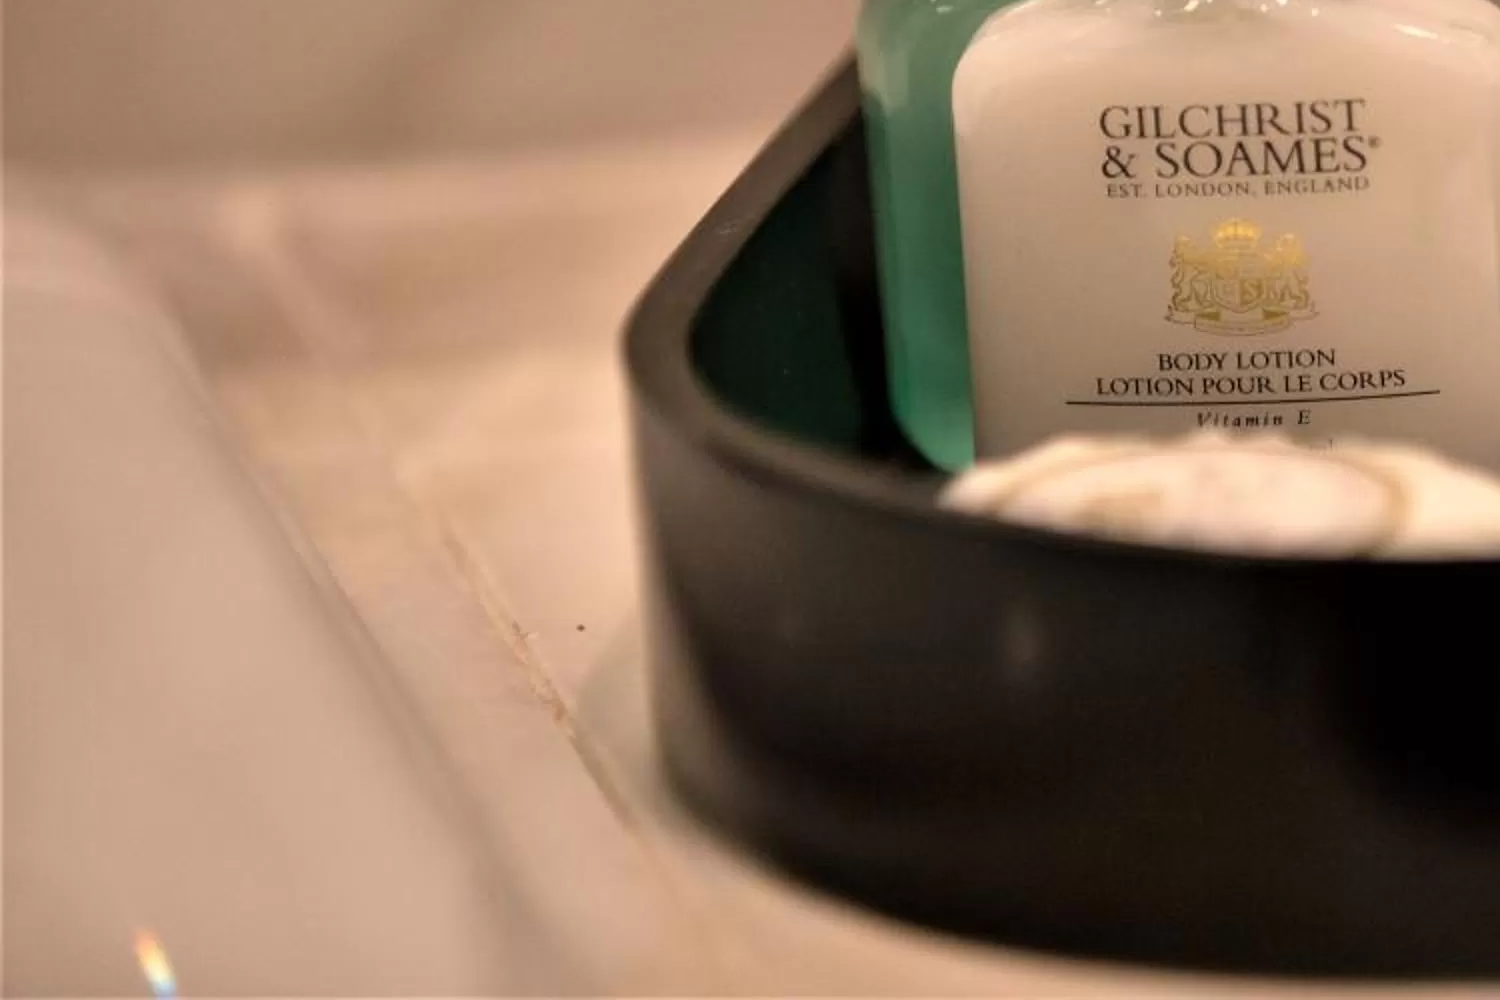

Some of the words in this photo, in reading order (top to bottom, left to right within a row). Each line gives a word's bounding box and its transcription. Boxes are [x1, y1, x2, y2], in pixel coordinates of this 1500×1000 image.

[1100, 98, 1366, 139] GILCHRIST
[1101, 145, 1136, 179] &
[1264, 175, 1371, 196] ENGLAND
[1156, 351, 1229, 373] BODY
[1235, 348, 1336, 371] LOTION
[1095, 376, 1195, 396] LOTION
[1202, 374, 1278, 396] POUR
[1283, 374, 1314, 394] LE
[1319, 369, 1406, 392] CORPS
[1196, 411, 1284, 428] Vitamin
[1297, 408, 1313, 425] E
